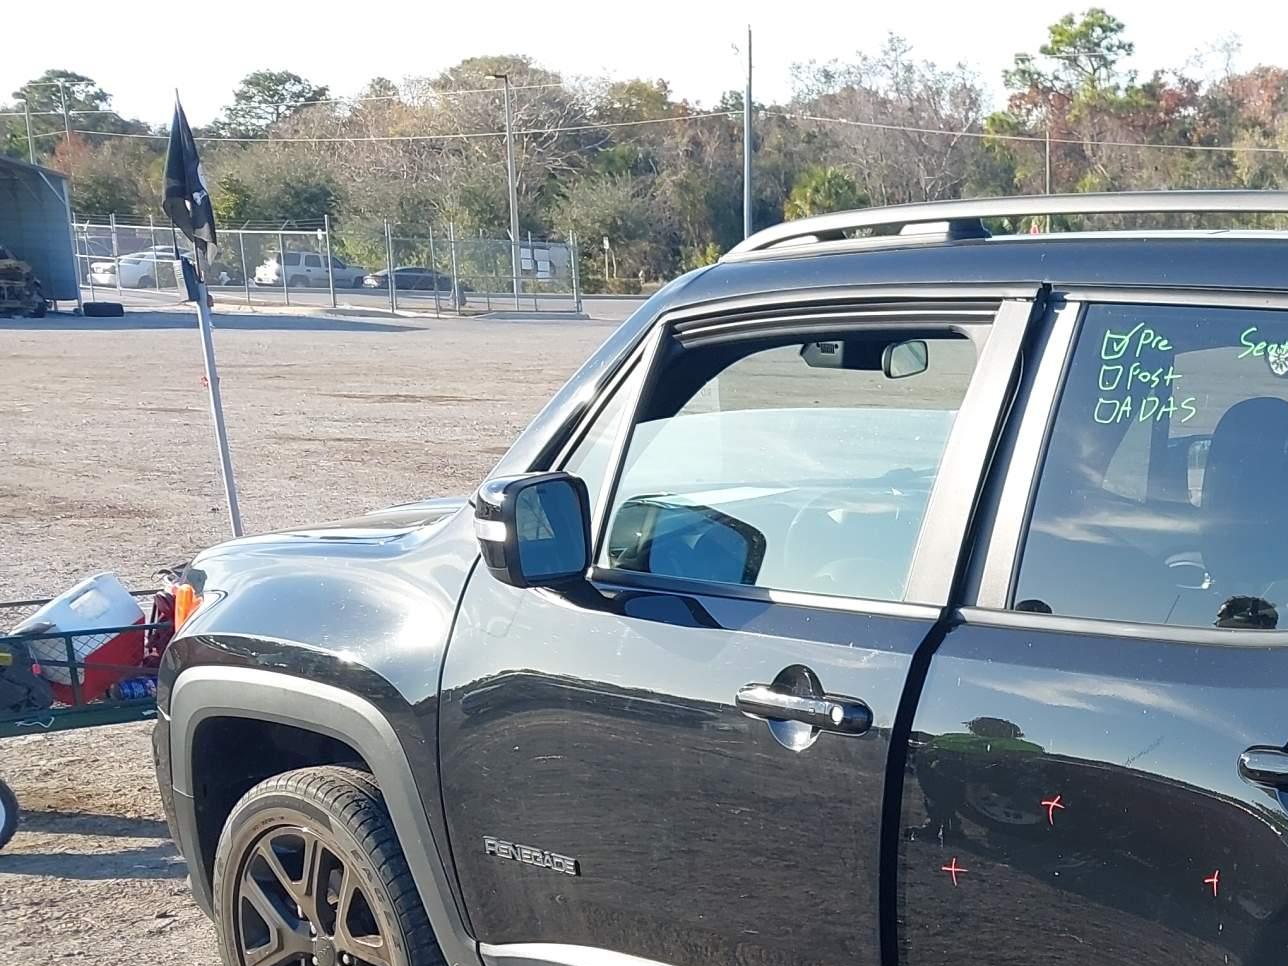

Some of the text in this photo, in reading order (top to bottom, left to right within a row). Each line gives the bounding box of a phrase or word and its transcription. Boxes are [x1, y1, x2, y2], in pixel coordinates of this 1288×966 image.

[1136, 330, 1173, 357] Pre
[1127, 365, 1182, 391] Post
[1116, 397, 1197, 423] ADAS
[483, 835, 578, 876] RENEGADE
